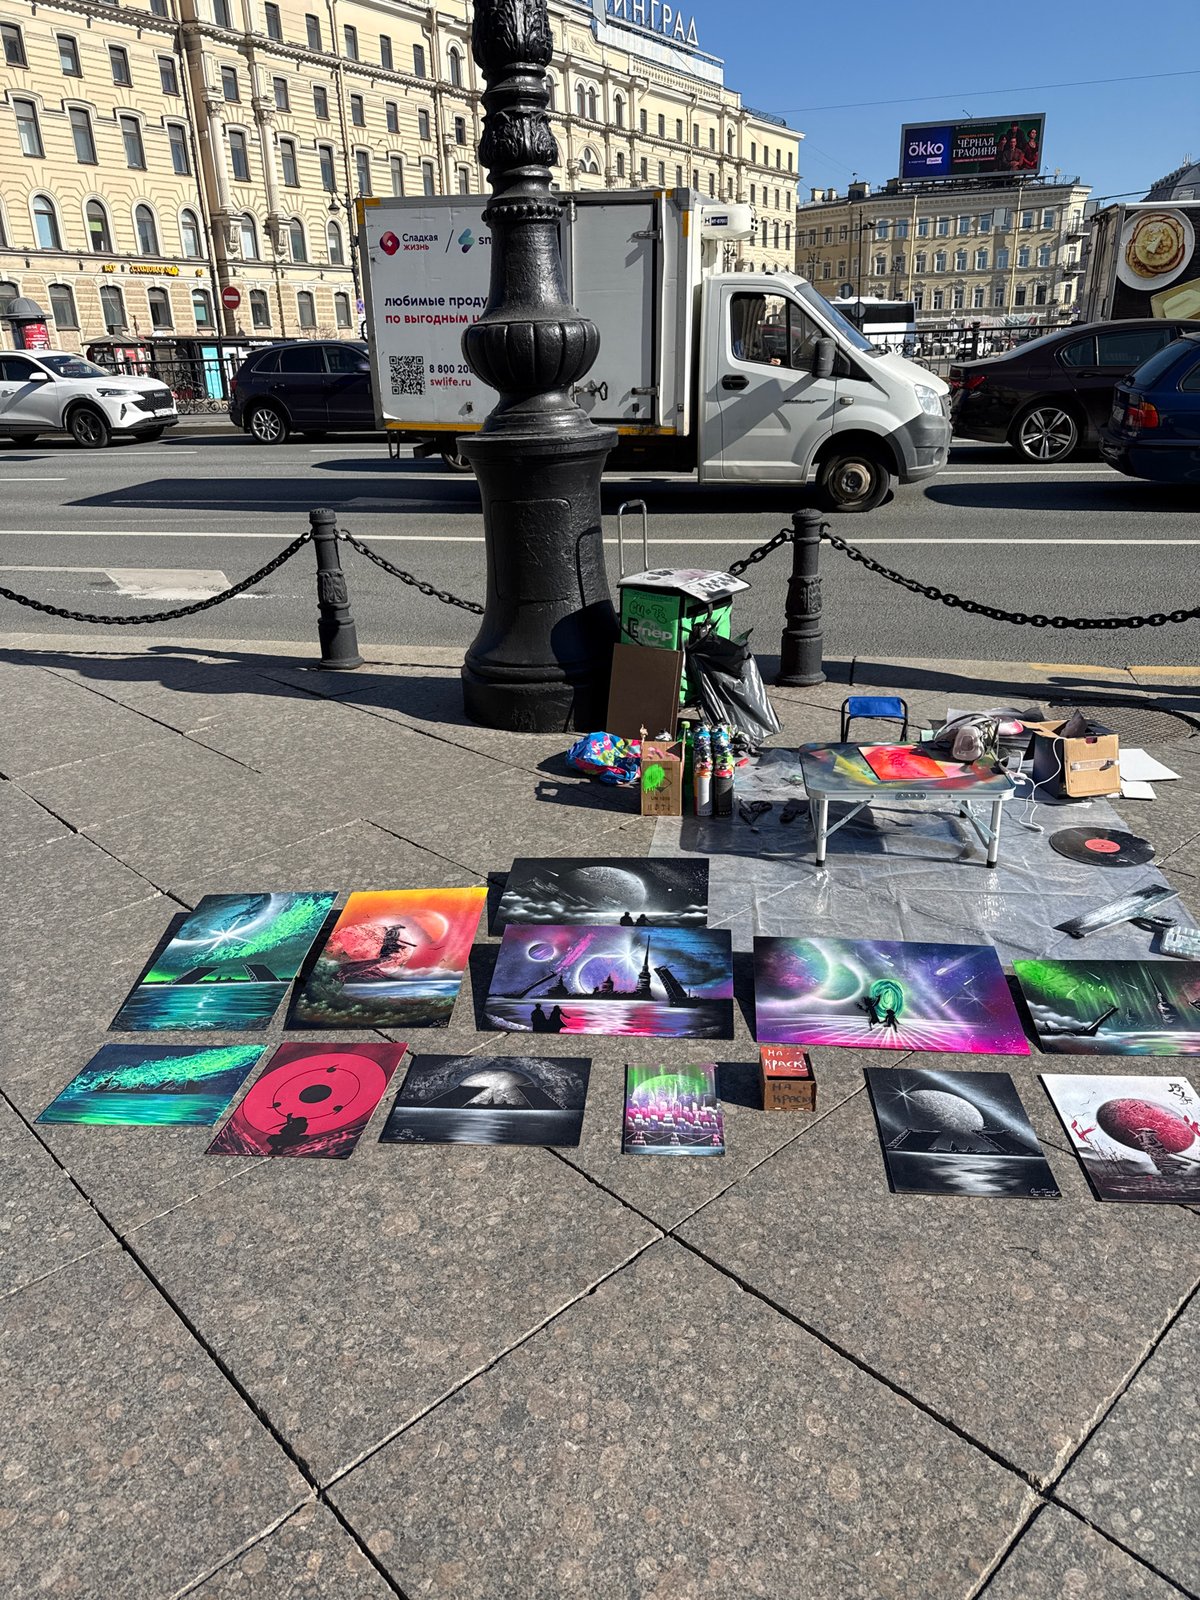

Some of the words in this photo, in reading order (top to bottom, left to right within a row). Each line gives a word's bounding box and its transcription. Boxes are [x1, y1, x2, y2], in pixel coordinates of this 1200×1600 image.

[605, 0, 699, 46] ИНГРАД
[957, 137, 994, 148] ЧЁРНАЯ
[952, 146, 997, 158] ГРАФИНЯ
[402, 233, 438, 242] Сладкая
[384, 295, 445, 307] любимые
[449, 296, 488, 309] проду
[385, 315, 400, 324] по
[404, 315, 468, 326] выгодным
[429, 364, 435, 373] 8
[437, 364, 455, 374] 800
[430, 377, 472, 387] swlife.ru
[772, 1083, 791, 1091] НА
